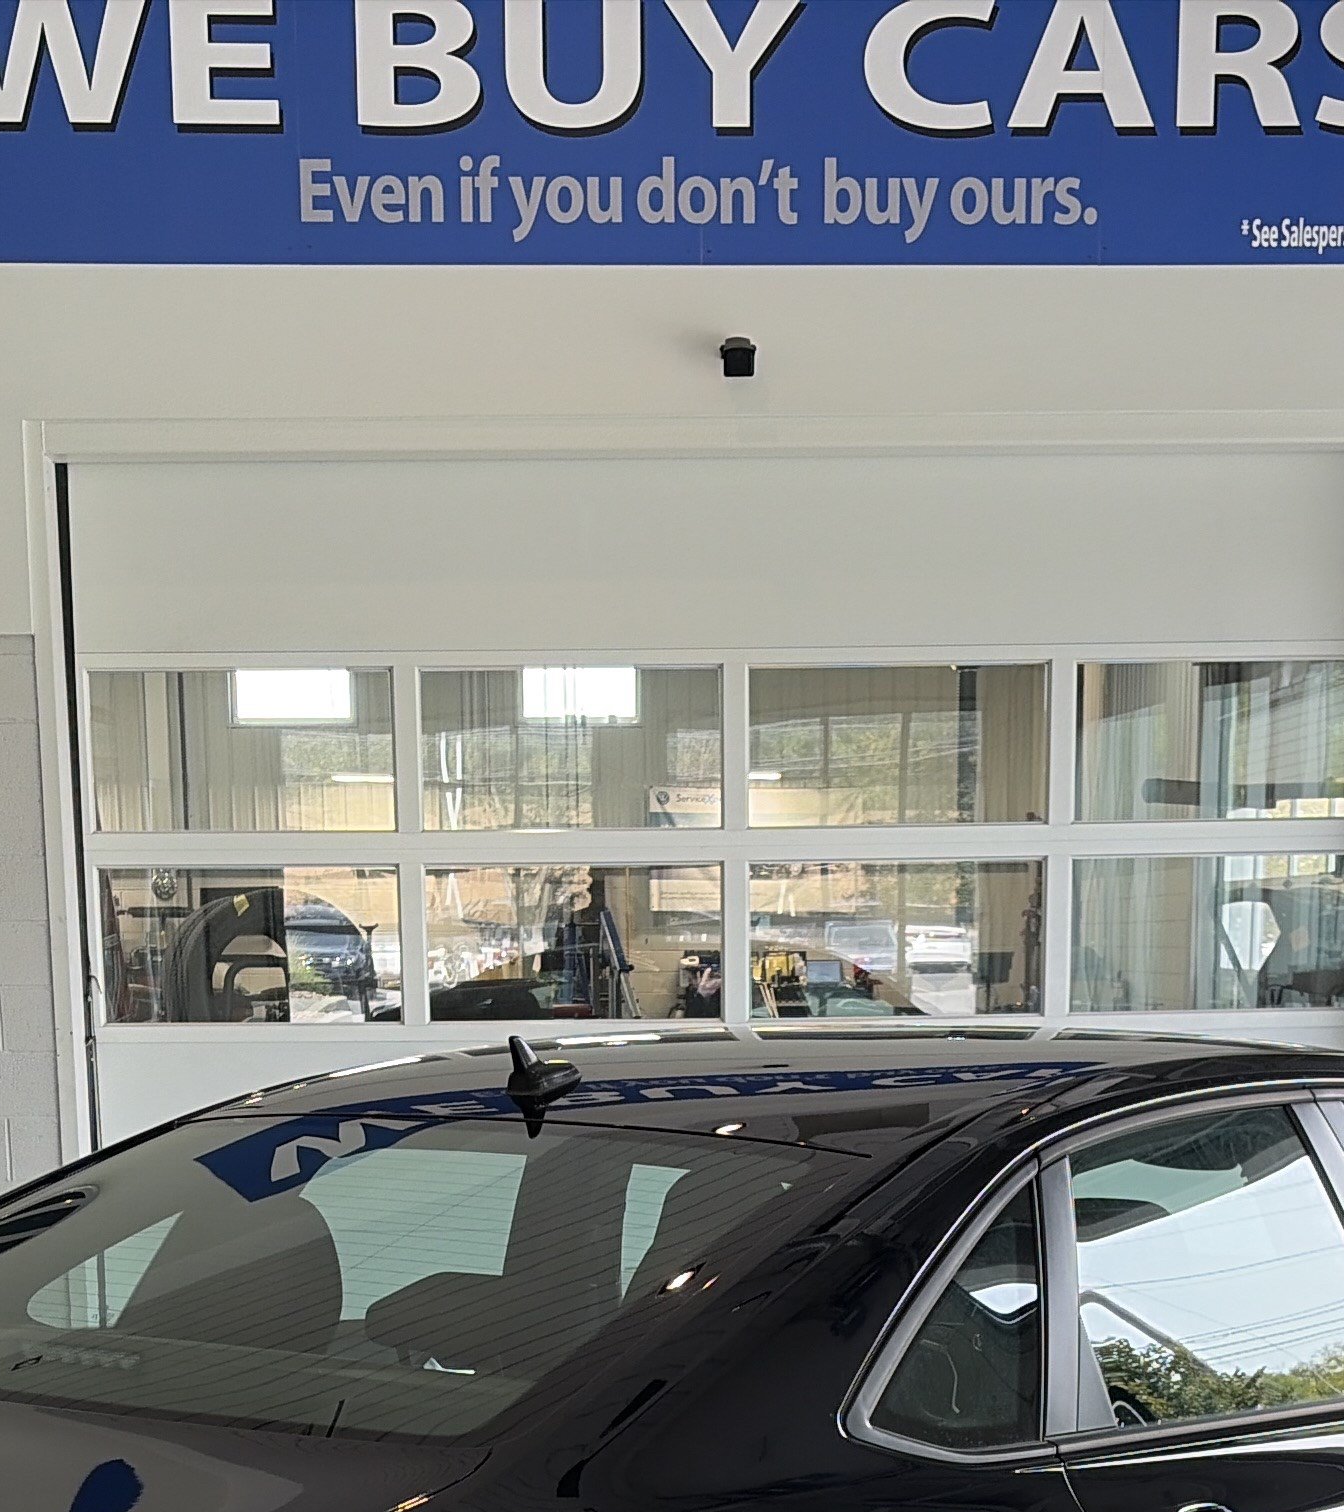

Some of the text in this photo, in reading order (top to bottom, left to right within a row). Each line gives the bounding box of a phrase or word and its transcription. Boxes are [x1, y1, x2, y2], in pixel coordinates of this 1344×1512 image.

[353, 0, 811, 137] BUY
[299, 156, 1098, 244] Even if you don't buy ours.
